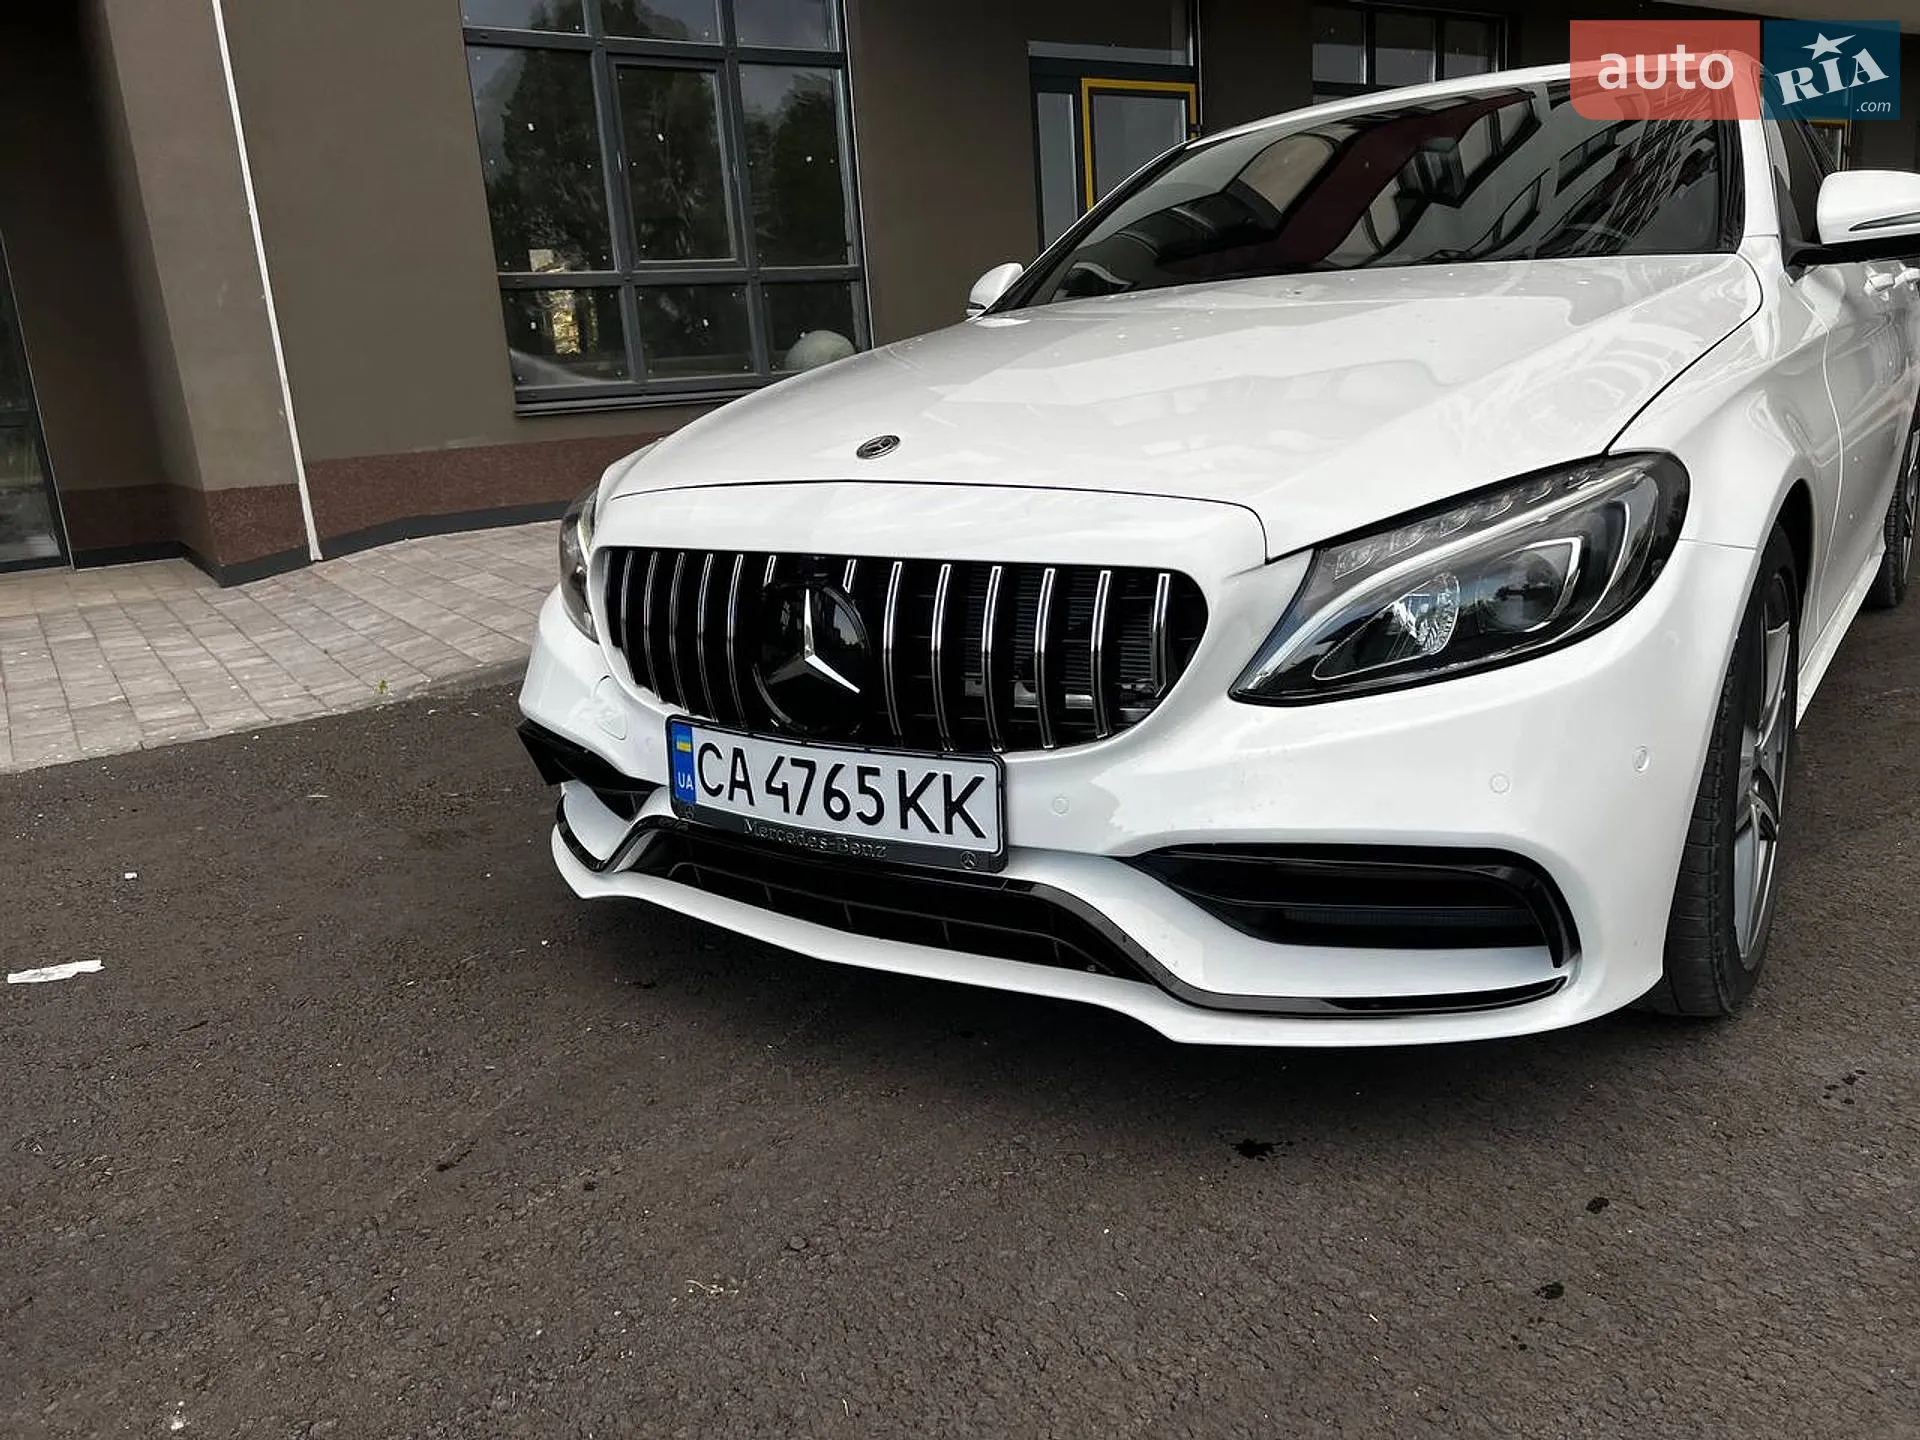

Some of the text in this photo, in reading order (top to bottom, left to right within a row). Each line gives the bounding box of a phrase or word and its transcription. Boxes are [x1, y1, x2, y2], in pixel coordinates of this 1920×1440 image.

[677, 770, 695, 791] UA
[698, 742, 987, 839] CA 4765 KK
[743, 819, 888, 859] Mercedes-Benz
